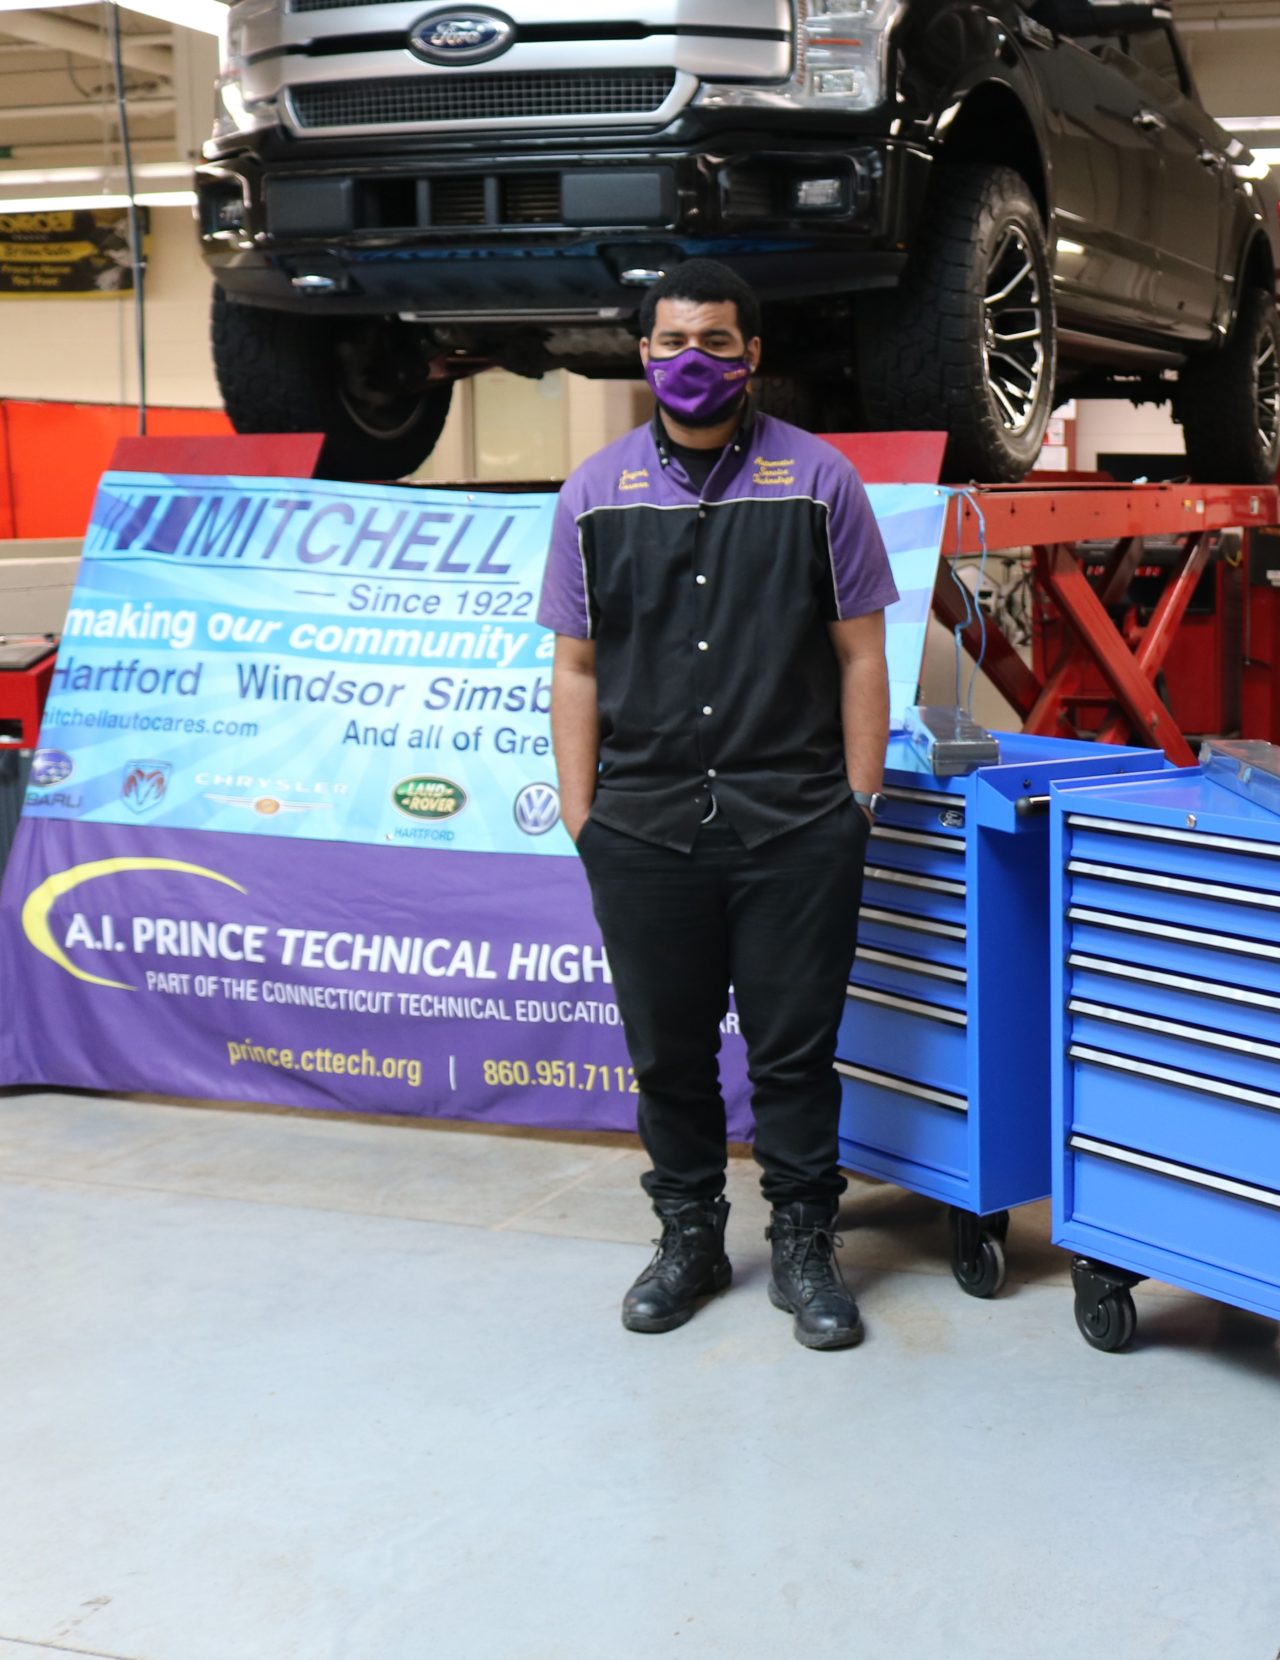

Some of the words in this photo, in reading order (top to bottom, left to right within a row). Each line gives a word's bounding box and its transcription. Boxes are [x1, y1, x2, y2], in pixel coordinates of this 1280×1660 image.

[430, 21, 486, 46] Ford
[184, 496, 515, 575] MITCHELL
[348, 584, 441, 615] Since
[457, 590, 534, 617] 1922
[63, 602, 197, 650] making
[207, 611, 282, 643] our
[289, 623, 529, 668] community
[237, 662, 406, 708] Windsor
[42, 707, 259, 737] itchellautocares.com
[342, 720, 399, 747] And
[407, 725, 443, 749] all
[453, 726, 483, 751] of
[194, 772, 349, 796] CHRYSLER
[407, 782, 444, 796] LAND
[409, 797, 455, 813] ROVER
[394, 827, 455, 842] HARTFORD
[65, 912, 125, 952] A.I.
[132, 916, 268, 963] PRINCE
[277, 927, 498, 980] TECHNICAL
[507, 942, 614, 985] HIGH
[146, 970, 191, 995] PART
[194, 975, 219, 998] OF
[220, 976, 259, 1001] THE
[262, 980, 393, 1014] CONNECTICUT
[397, 993, 513, 1022] TECHNICAL
[516, 999, 624, 1026] EDUCATIO
[226, 1037, 423, 1088] prince.cttech.org
[483, 1058, 641, 1095] 860.951.7112
